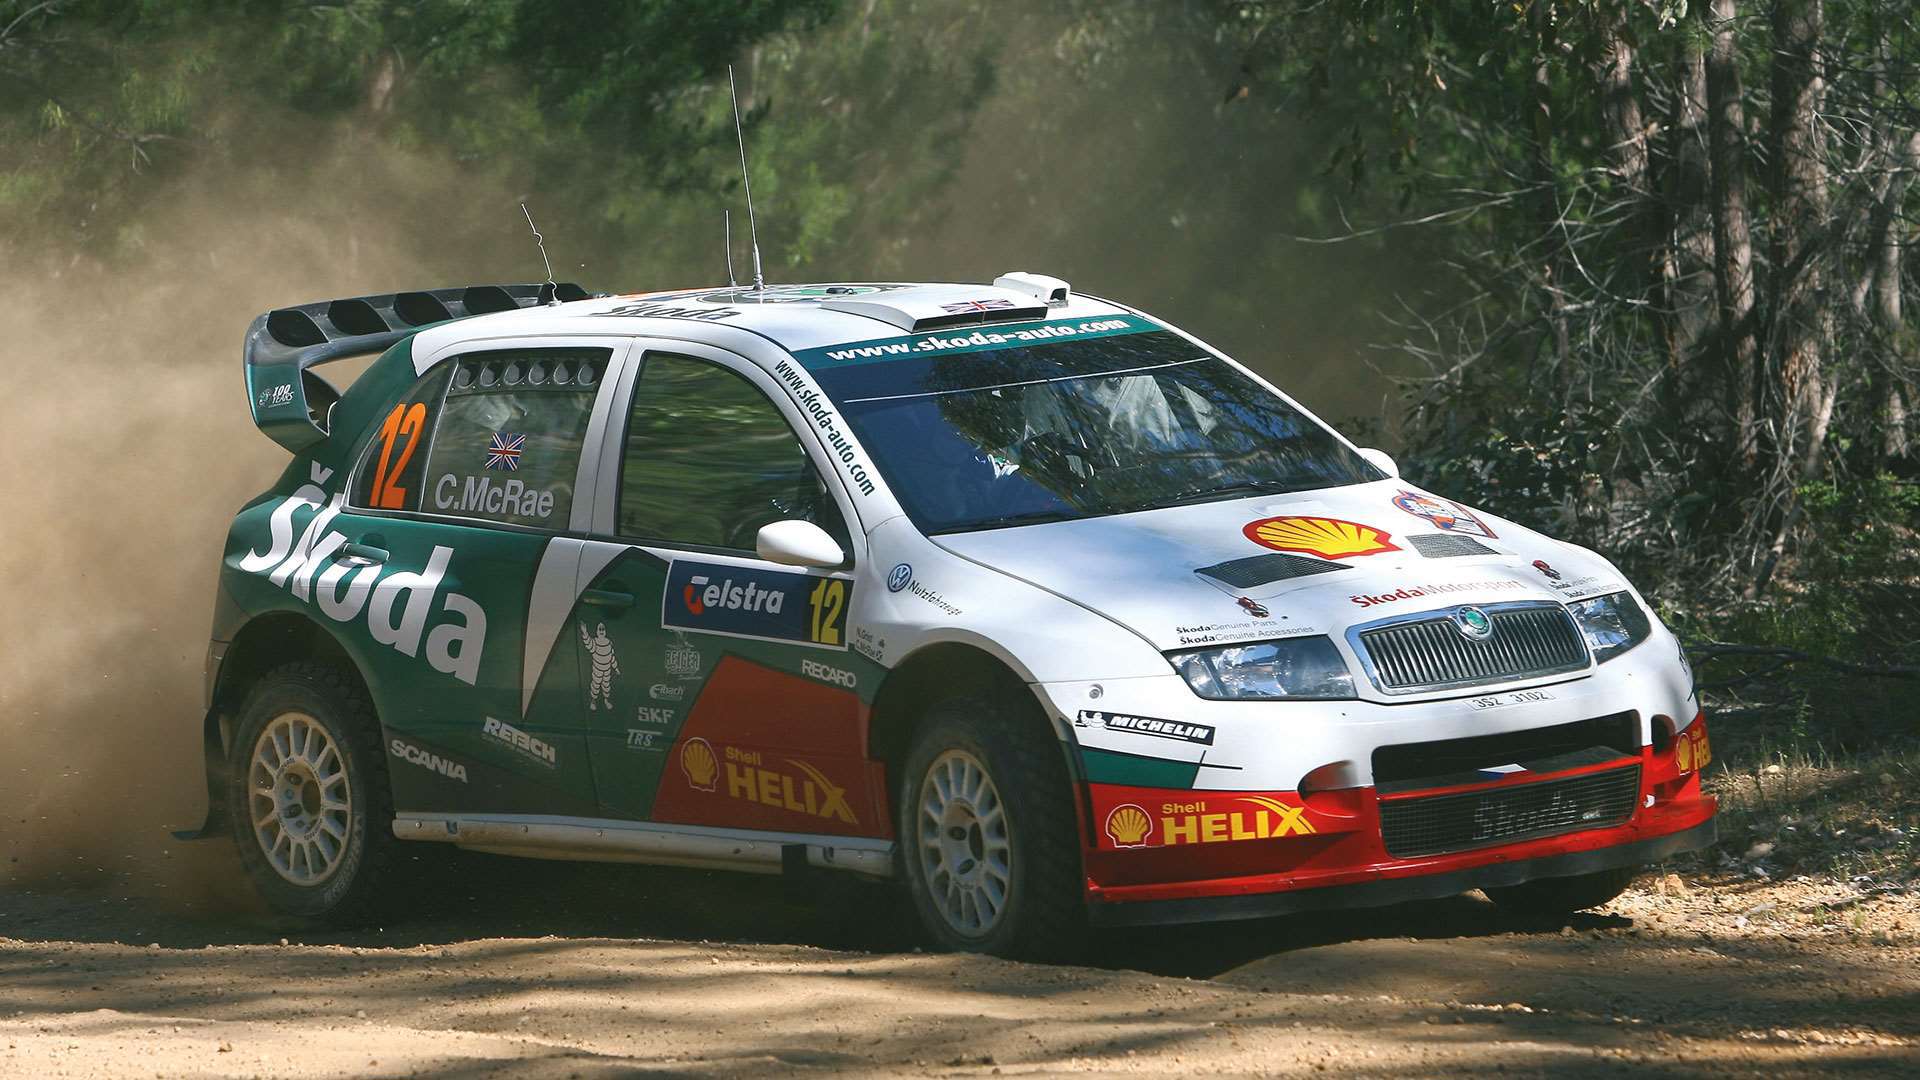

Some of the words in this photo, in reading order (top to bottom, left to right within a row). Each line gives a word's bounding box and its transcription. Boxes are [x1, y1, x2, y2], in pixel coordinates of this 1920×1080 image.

[826, 315, 1131, 362] www.skoda-auto.com
[272, 384, 292, 397] 100
[774, 359, 876, 498] www.skoda-auto.com
[369, 402, 427, 510] 12
[434, 473, 555, 519] C.McRae
[683, 575, 785, 616] Telstra
[810, 578, 846, 646] 12
[802, 659, 857, 689] RECARO
[637, 706, 674, 725] SKF
[1472, 697, 1504, 708] 3S2
[1509, 690, 1549, 703] 3102
[627, 728, 655, 747] TRS
[1109, 714, 1210, 740] MICHELIN
[390, 739, 468, 784] SCANIA
[725, 746, 762, 766] Shell
[724, 758, 860, 825] HELIX
[1161, 801, 1206, 815] Shell
[1160, 794, 1318, 846] HELIX
